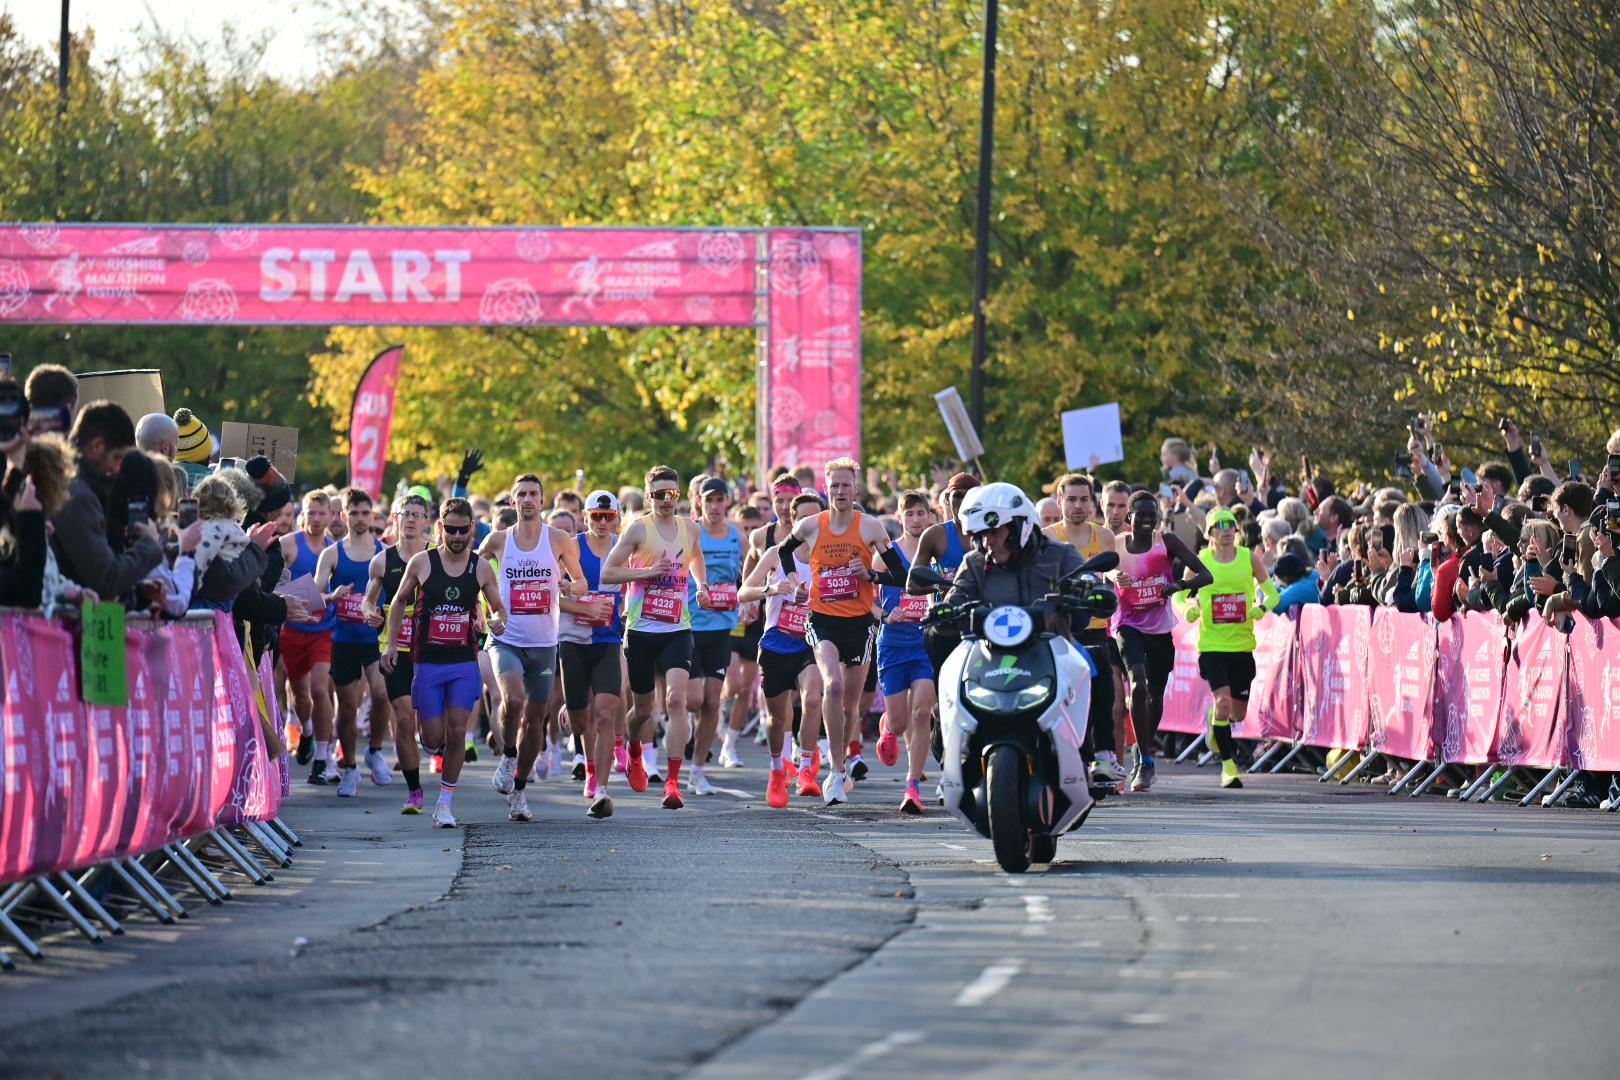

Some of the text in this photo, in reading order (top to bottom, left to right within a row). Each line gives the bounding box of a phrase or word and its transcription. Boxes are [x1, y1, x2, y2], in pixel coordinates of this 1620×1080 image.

[85, 258, 165, 271] YRKSHIRE
[85, 273, 166, 285] MARATHON
[259, 247, 471, 303] START
[356, 391, 388, 417] SUB
[357, 425, 378, 471] 2
[518, 558, 539, 567] Valley
[506, 567, 552, 579] Striders
[828, 578, 850, 588] 5036
[520, 592, 542, 601] 4194
[1137, 587, 1157, 597] 7581
[435, 604, 465, 612] ARMY
[652, 598, 674, 609] 4228
[909, 602, 928, 610] 6950
[1222, 603, 1237, 612] 296
[439, 623, 461, 633] 9198
[985, 667, 1032, 679] MOTOCAM
